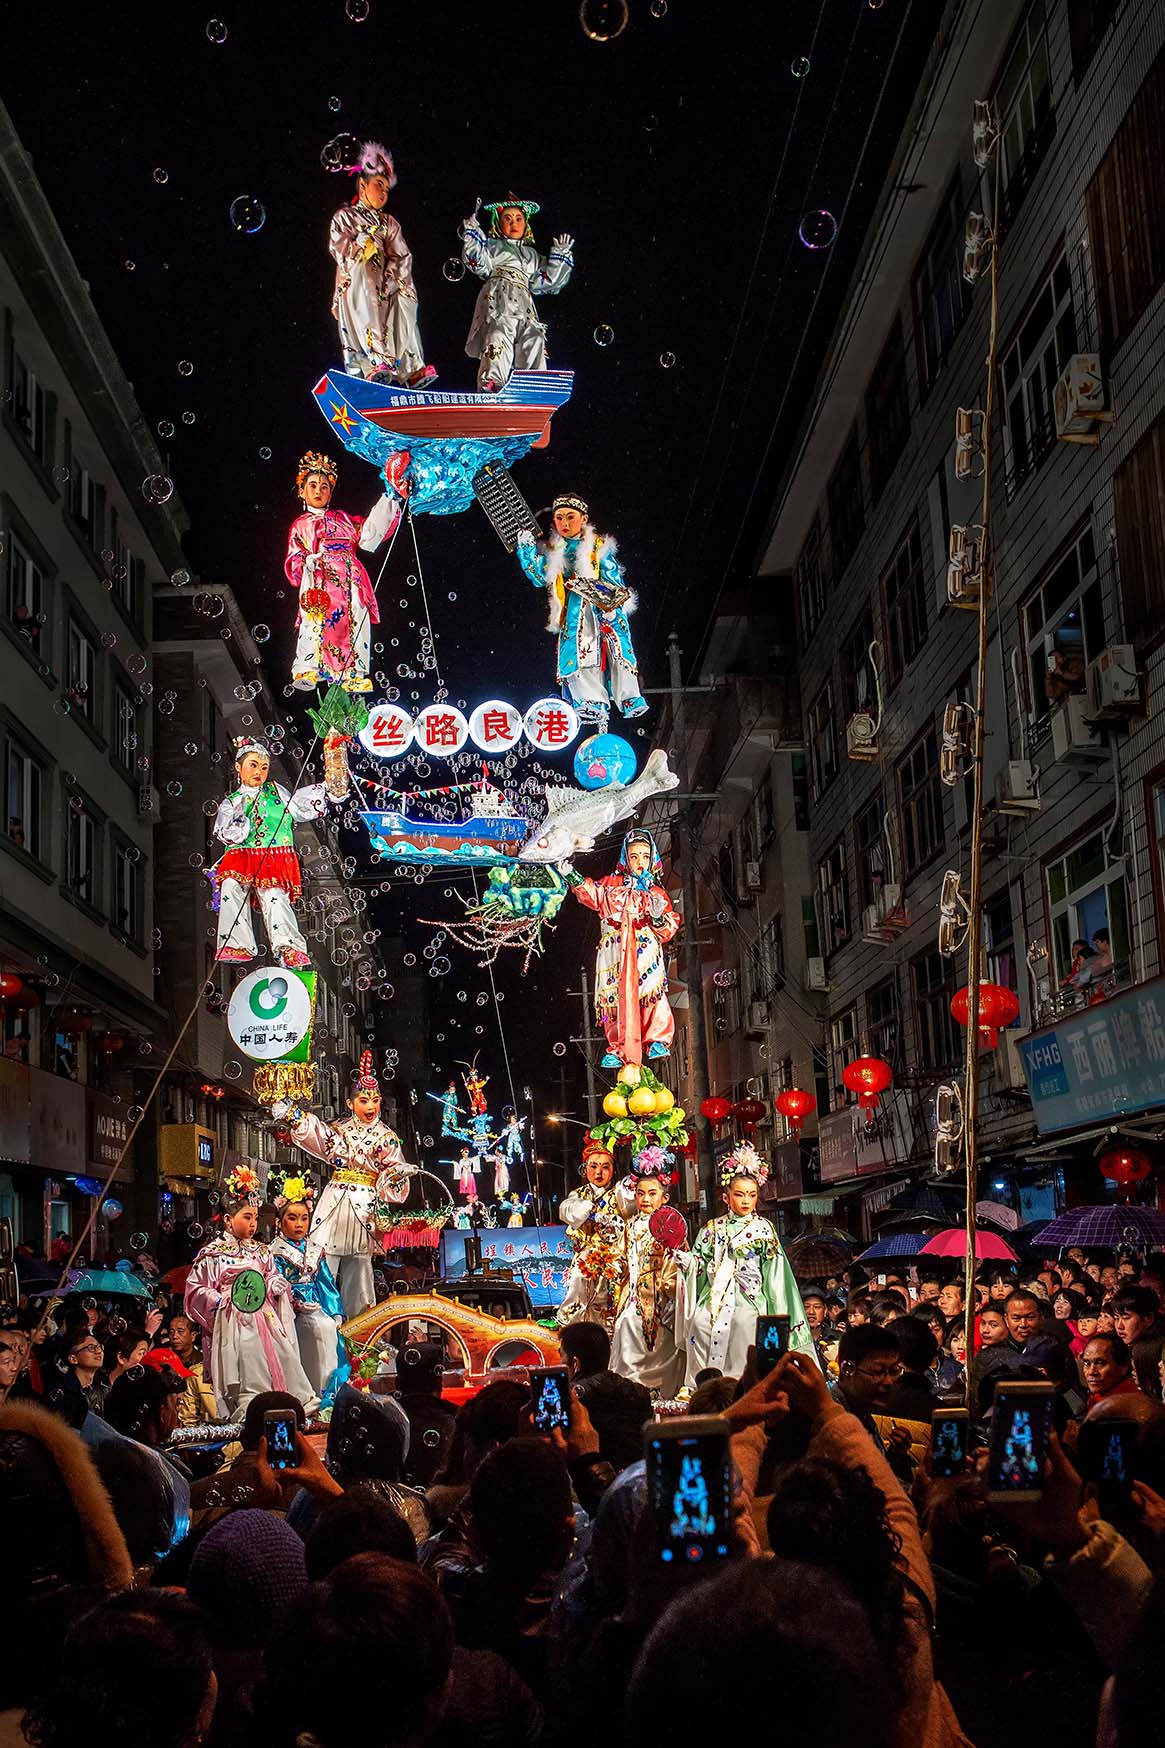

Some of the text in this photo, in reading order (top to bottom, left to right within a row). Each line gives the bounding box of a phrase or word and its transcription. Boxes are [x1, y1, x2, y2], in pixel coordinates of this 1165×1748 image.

[372, 708, 570, 747] 丝路良港
[239, 1032, 299, 1047] 中国人寿
[247, 1023, 288, 1033] CHINA LIFE
[1026, 1042, 1061, 1073] XFHG
